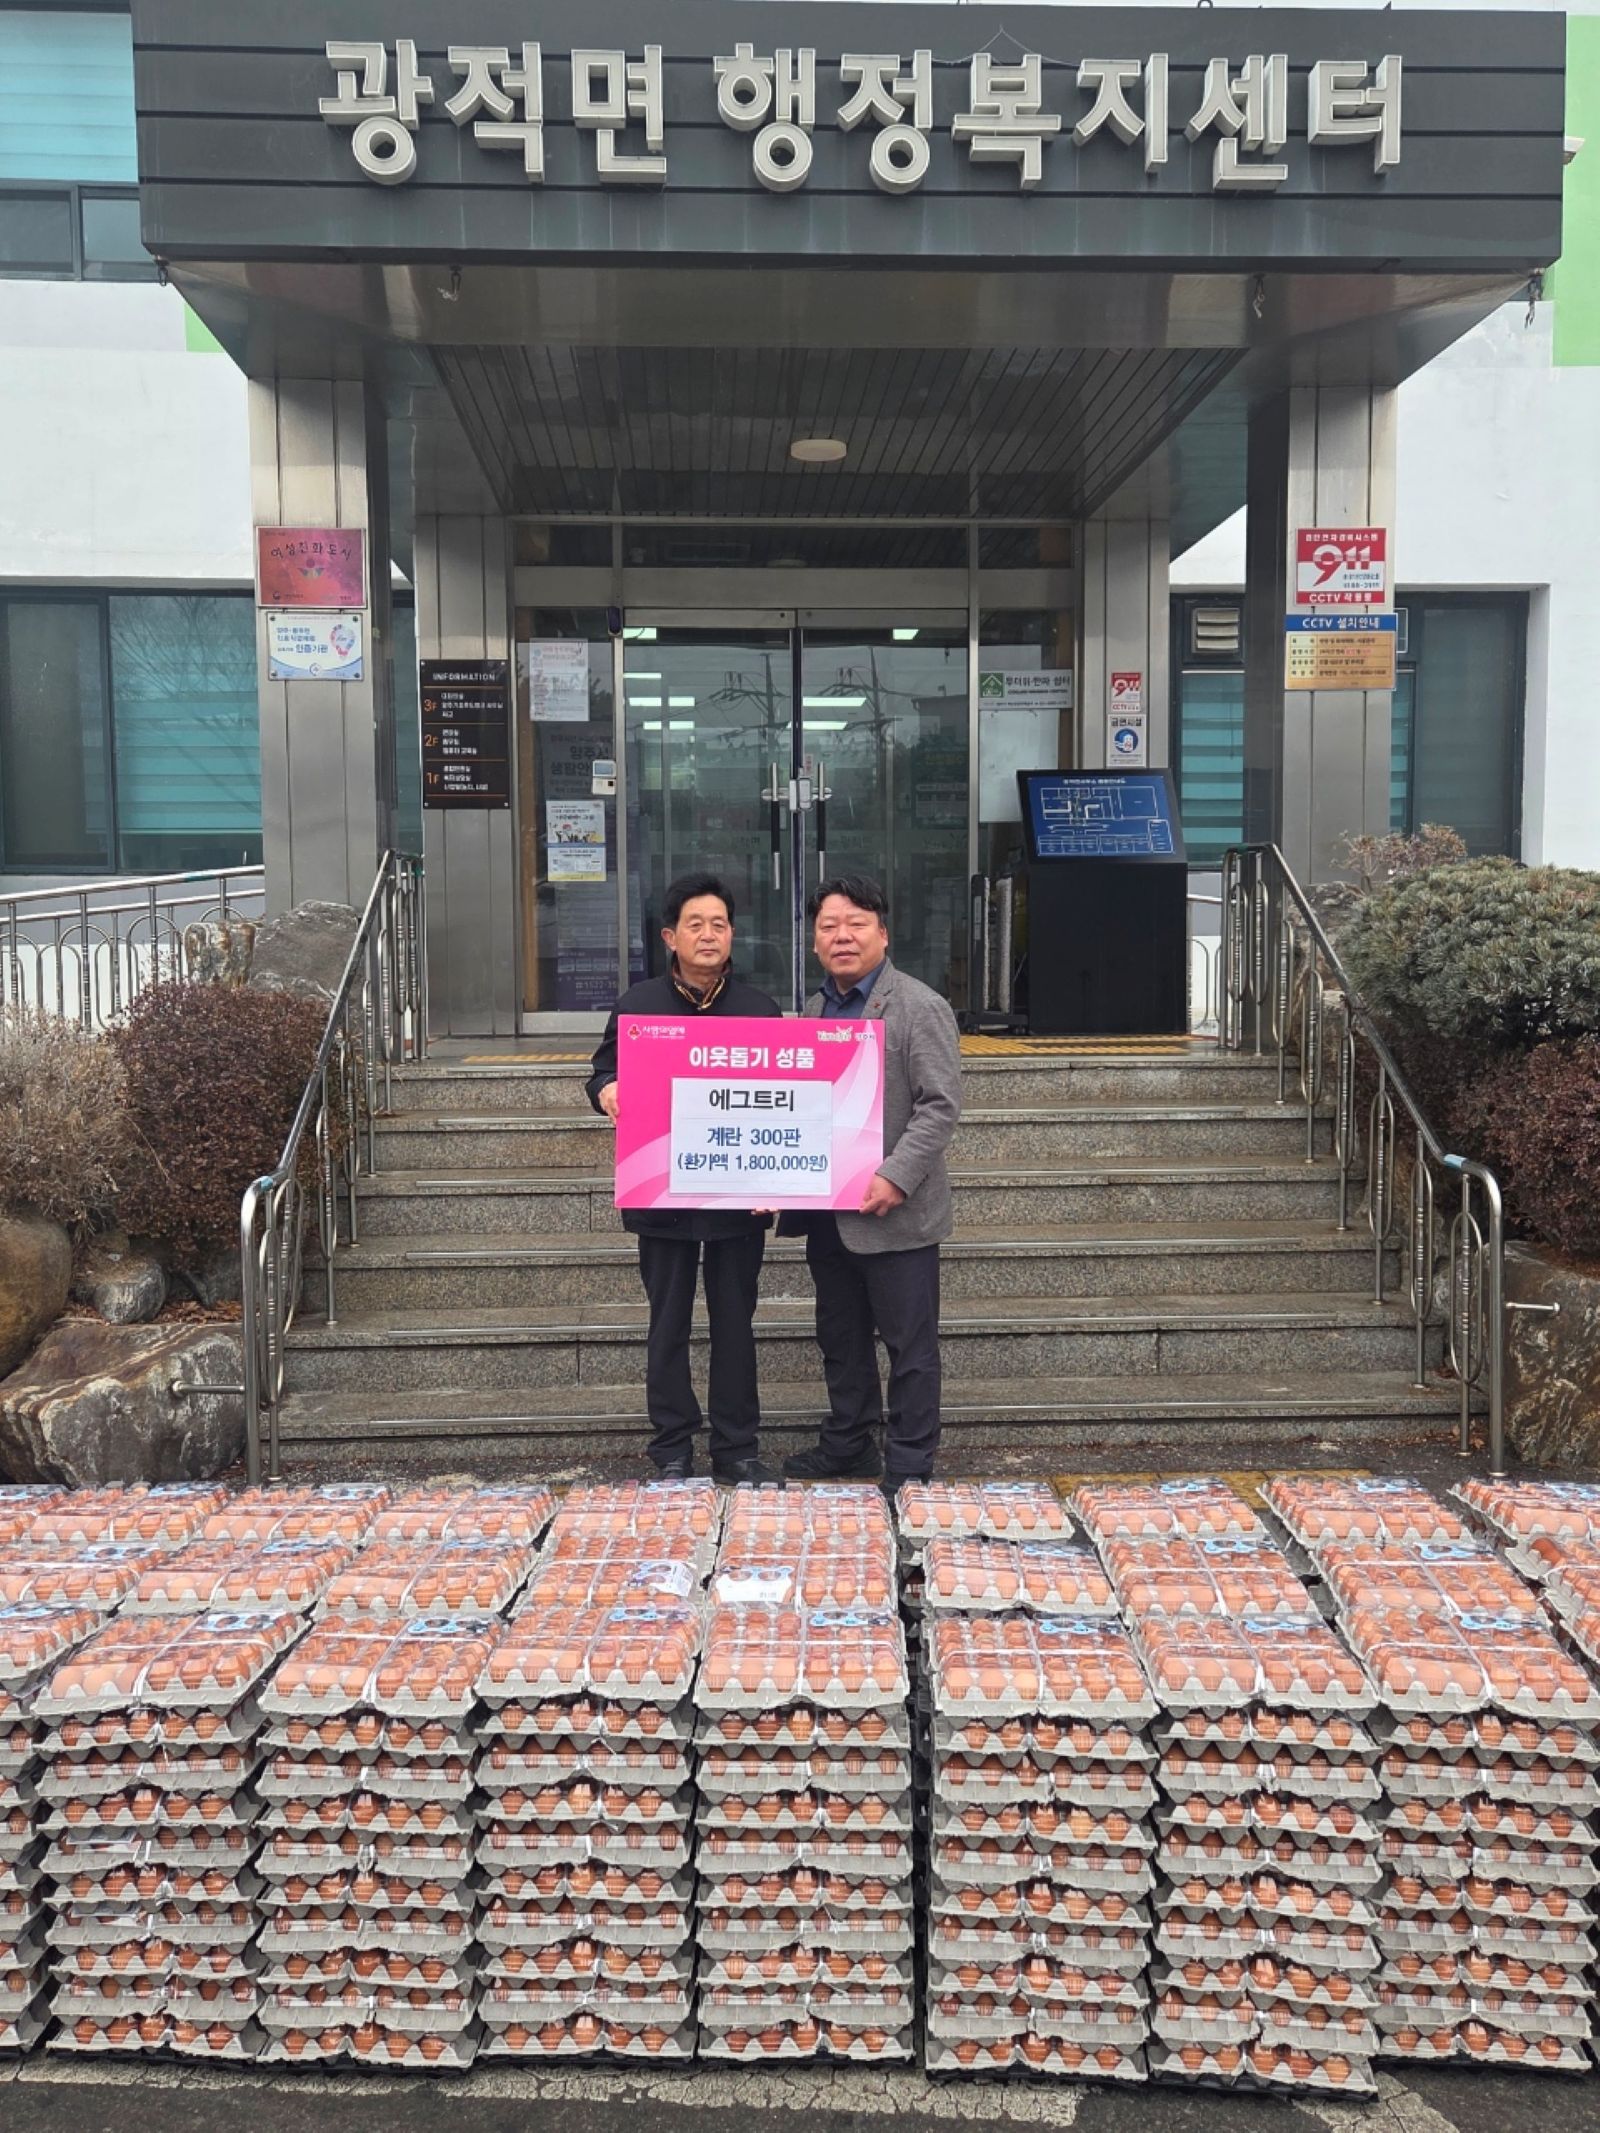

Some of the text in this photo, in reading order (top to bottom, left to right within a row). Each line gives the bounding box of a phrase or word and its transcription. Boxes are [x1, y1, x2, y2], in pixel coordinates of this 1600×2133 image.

[318, 39, 1403, 194] 광적면 행정복지센터
[1313, 544, 1371, 586] 911
[1309, 593, 1341, 603] CCTV
[1302, 616, 1381, 630] CCTV 설치안내
[433, 672, 496, 681] INFORMATION
[424, 698, 438, 712] 3F
[424, 734, 439, 747] 2F
[426, 772, 440, 785] 1F
[689, 1046, 816, 1070] 이웃돕기 성품
[709, 1089, 795, 1112] 에그트리
[707, 1127, 801, 1149] 계란 300판
[735, 1153, 829, 1173] 1,800,000원)
